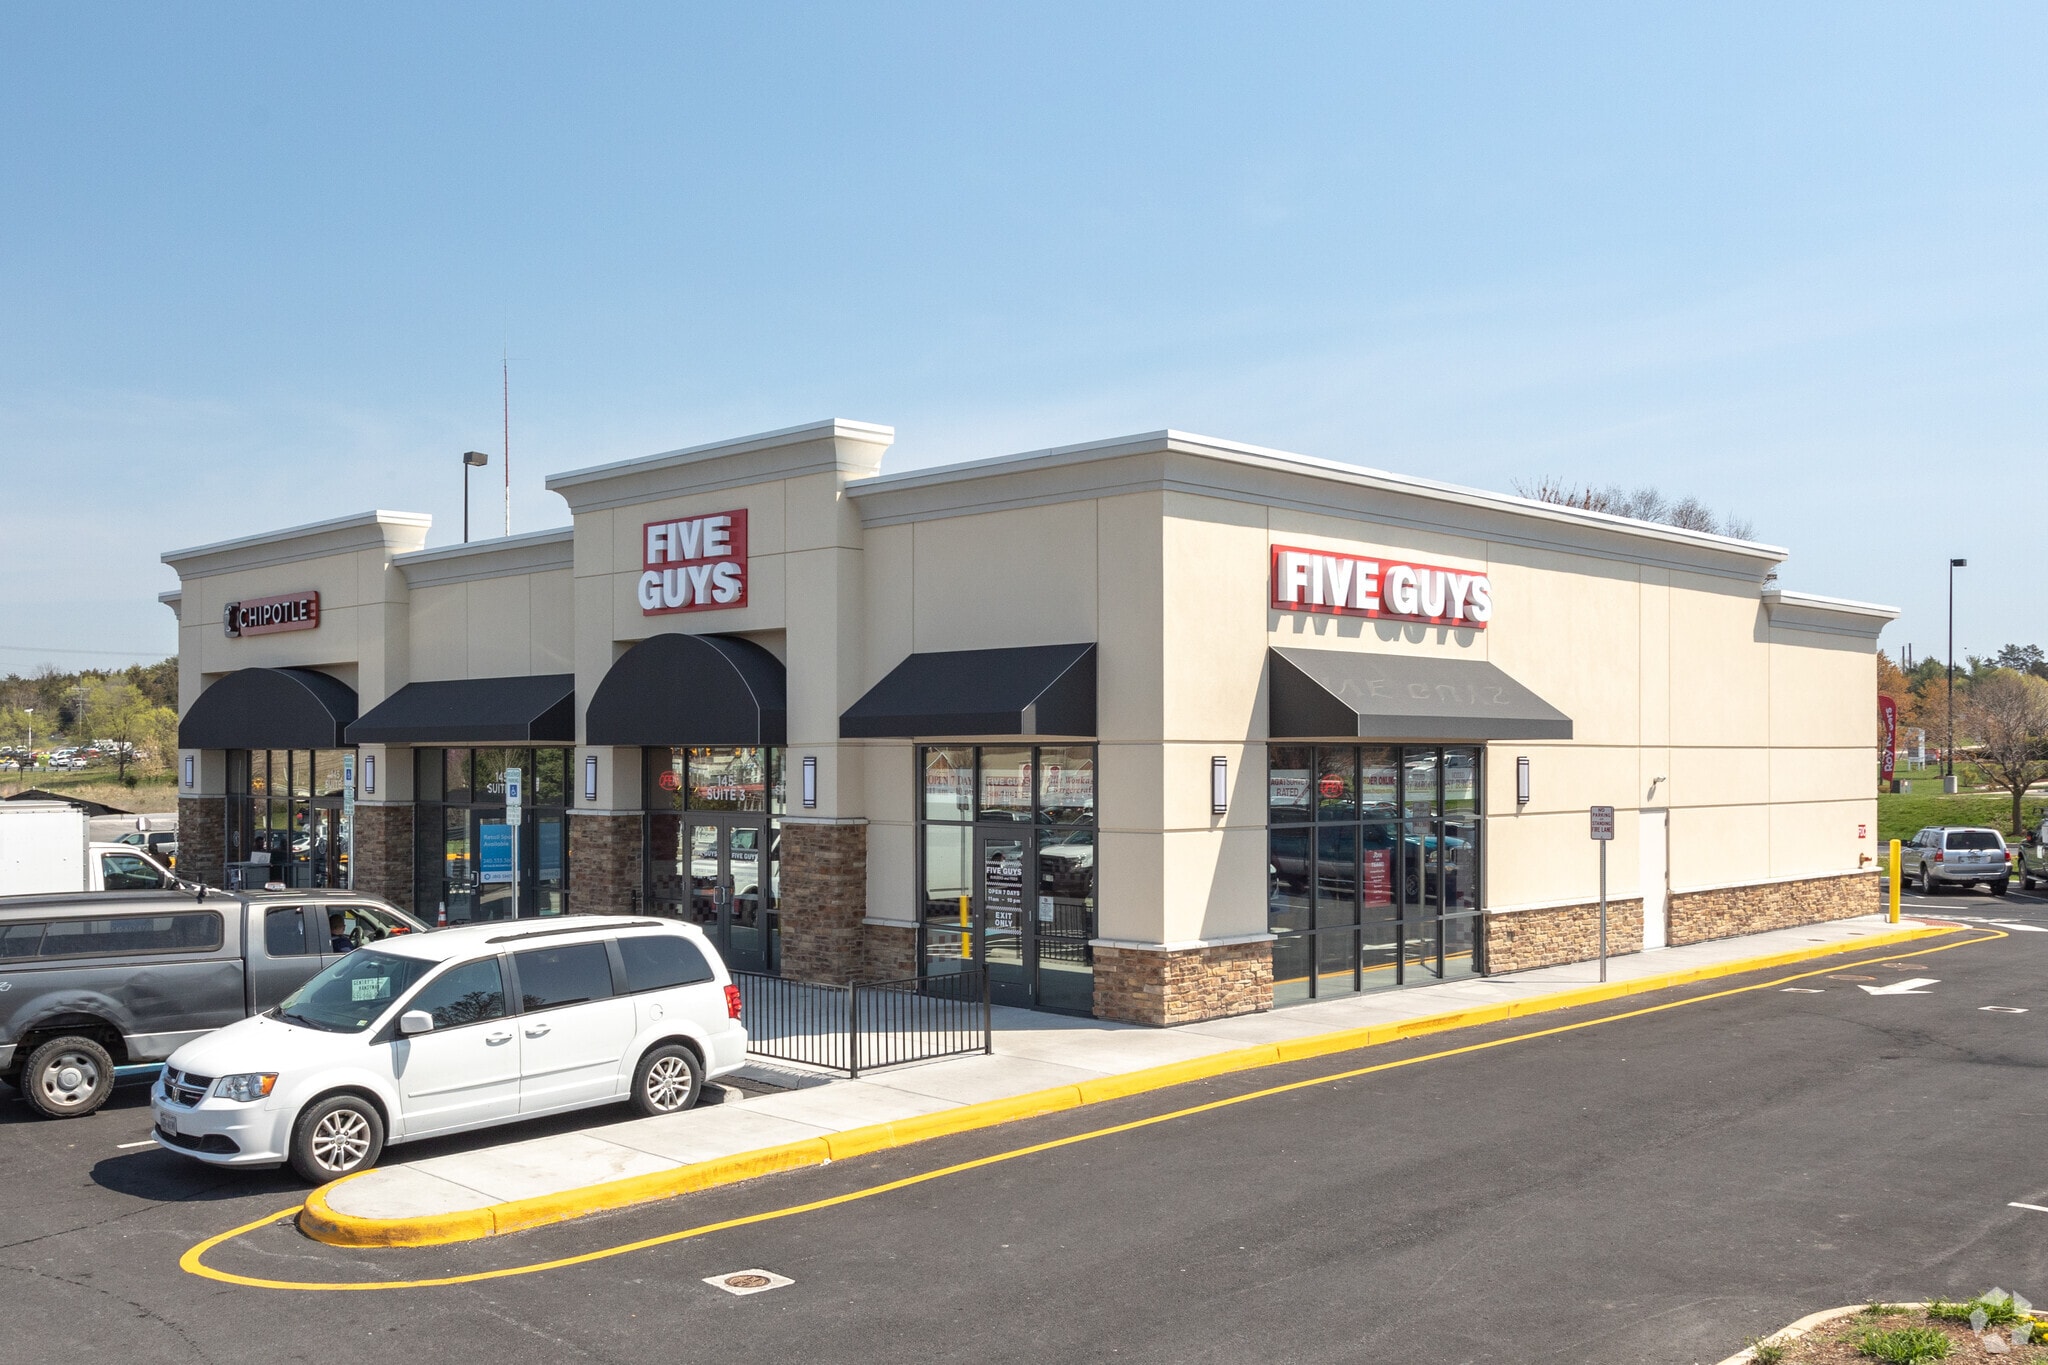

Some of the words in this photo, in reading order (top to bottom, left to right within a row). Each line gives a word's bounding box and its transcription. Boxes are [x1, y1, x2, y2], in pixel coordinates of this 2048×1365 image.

[647, 516, 731, 564] FIVE
[638, 562, 742, 610] GUYS
[1278, 551, 1380, 611] FIVE
[1383, 565, 1493, 622] GUYS
[240, 600, 308, 627] CHIPOTLE
[1884, 748, 1894, 772] Roy
[717, 775, 735, 788] 145
[928, 775, 948, 785] OPEN
[957, 776, 973, 785] DAY
[986, 777, 1005, 786] FIVE
[1363, 776, 1378, 785] RDER
[487, 783, 507, 793] SUIT
[1276, 788, 1299, 797] RATED
[707, 788, 737, 801] SUITE
[739, 788, 746, 801] 3
[986, 866, 1001, 874] FIVE
[1003, 867, 1022, 876] GUYS
[988, 888, 1002, 896] OPEN
[995, 911, 1013, 920] EXIT
[994, 919, 1013, 927] ONLY
